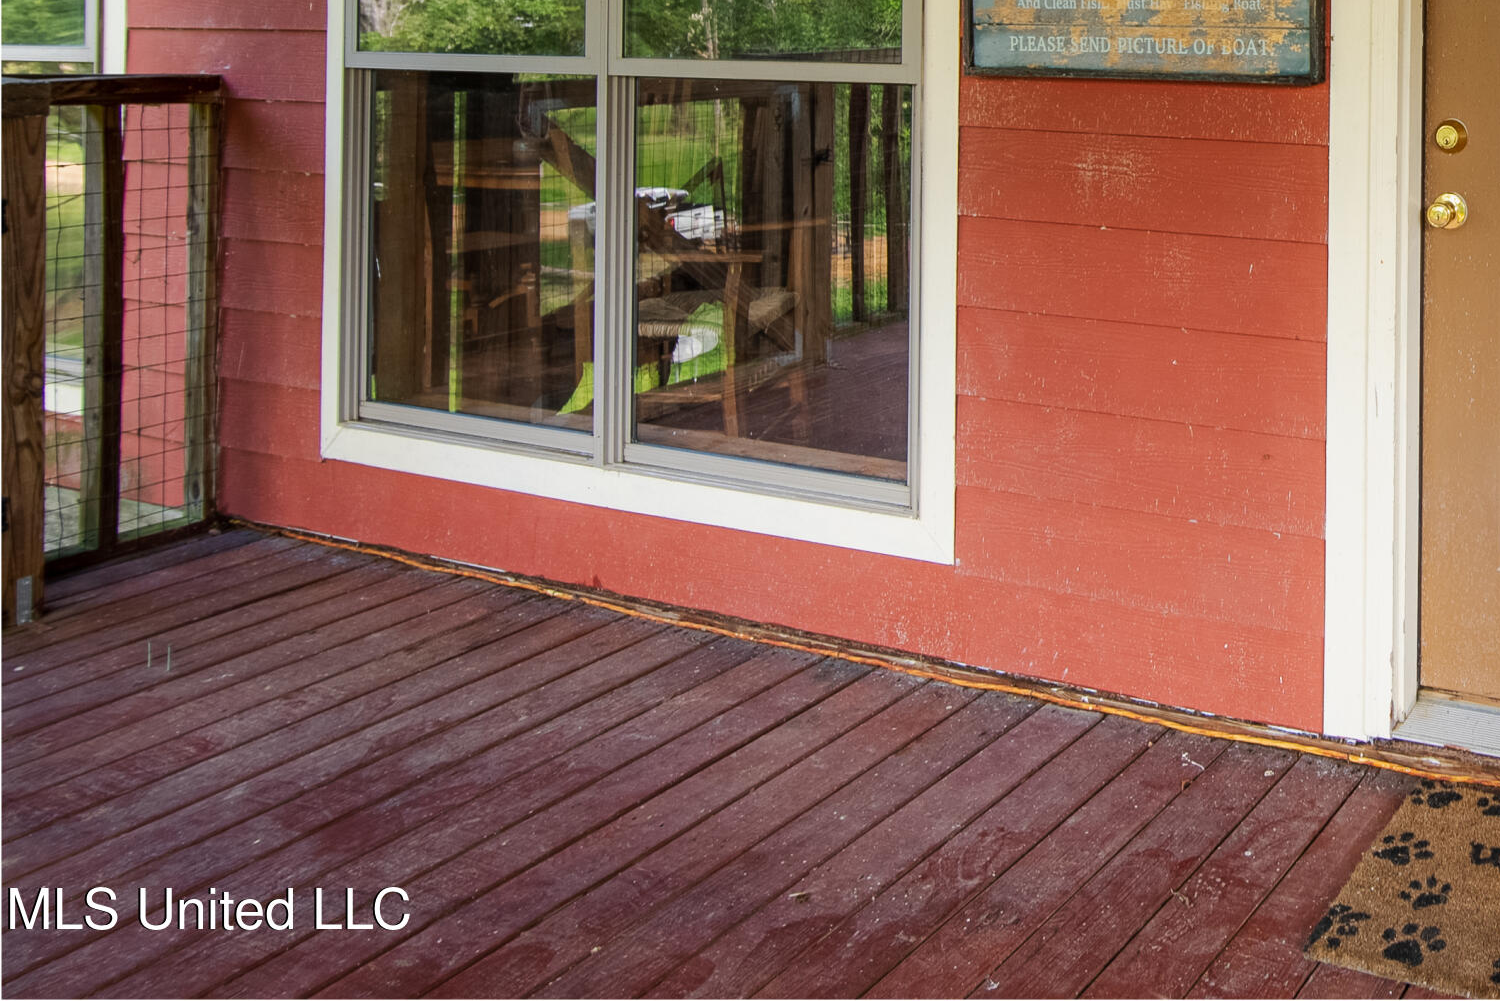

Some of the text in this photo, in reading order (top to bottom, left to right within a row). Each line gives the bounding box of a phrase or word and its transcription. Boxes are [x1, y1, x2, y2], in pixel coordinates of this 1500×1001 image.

[1009, 36, 1066, 52] PLEASE
[1070, 37, 1111, 52] SEND
[1118, 37, 1188, 54] PICTURE
[1193, 38, 1216, 55] OF
